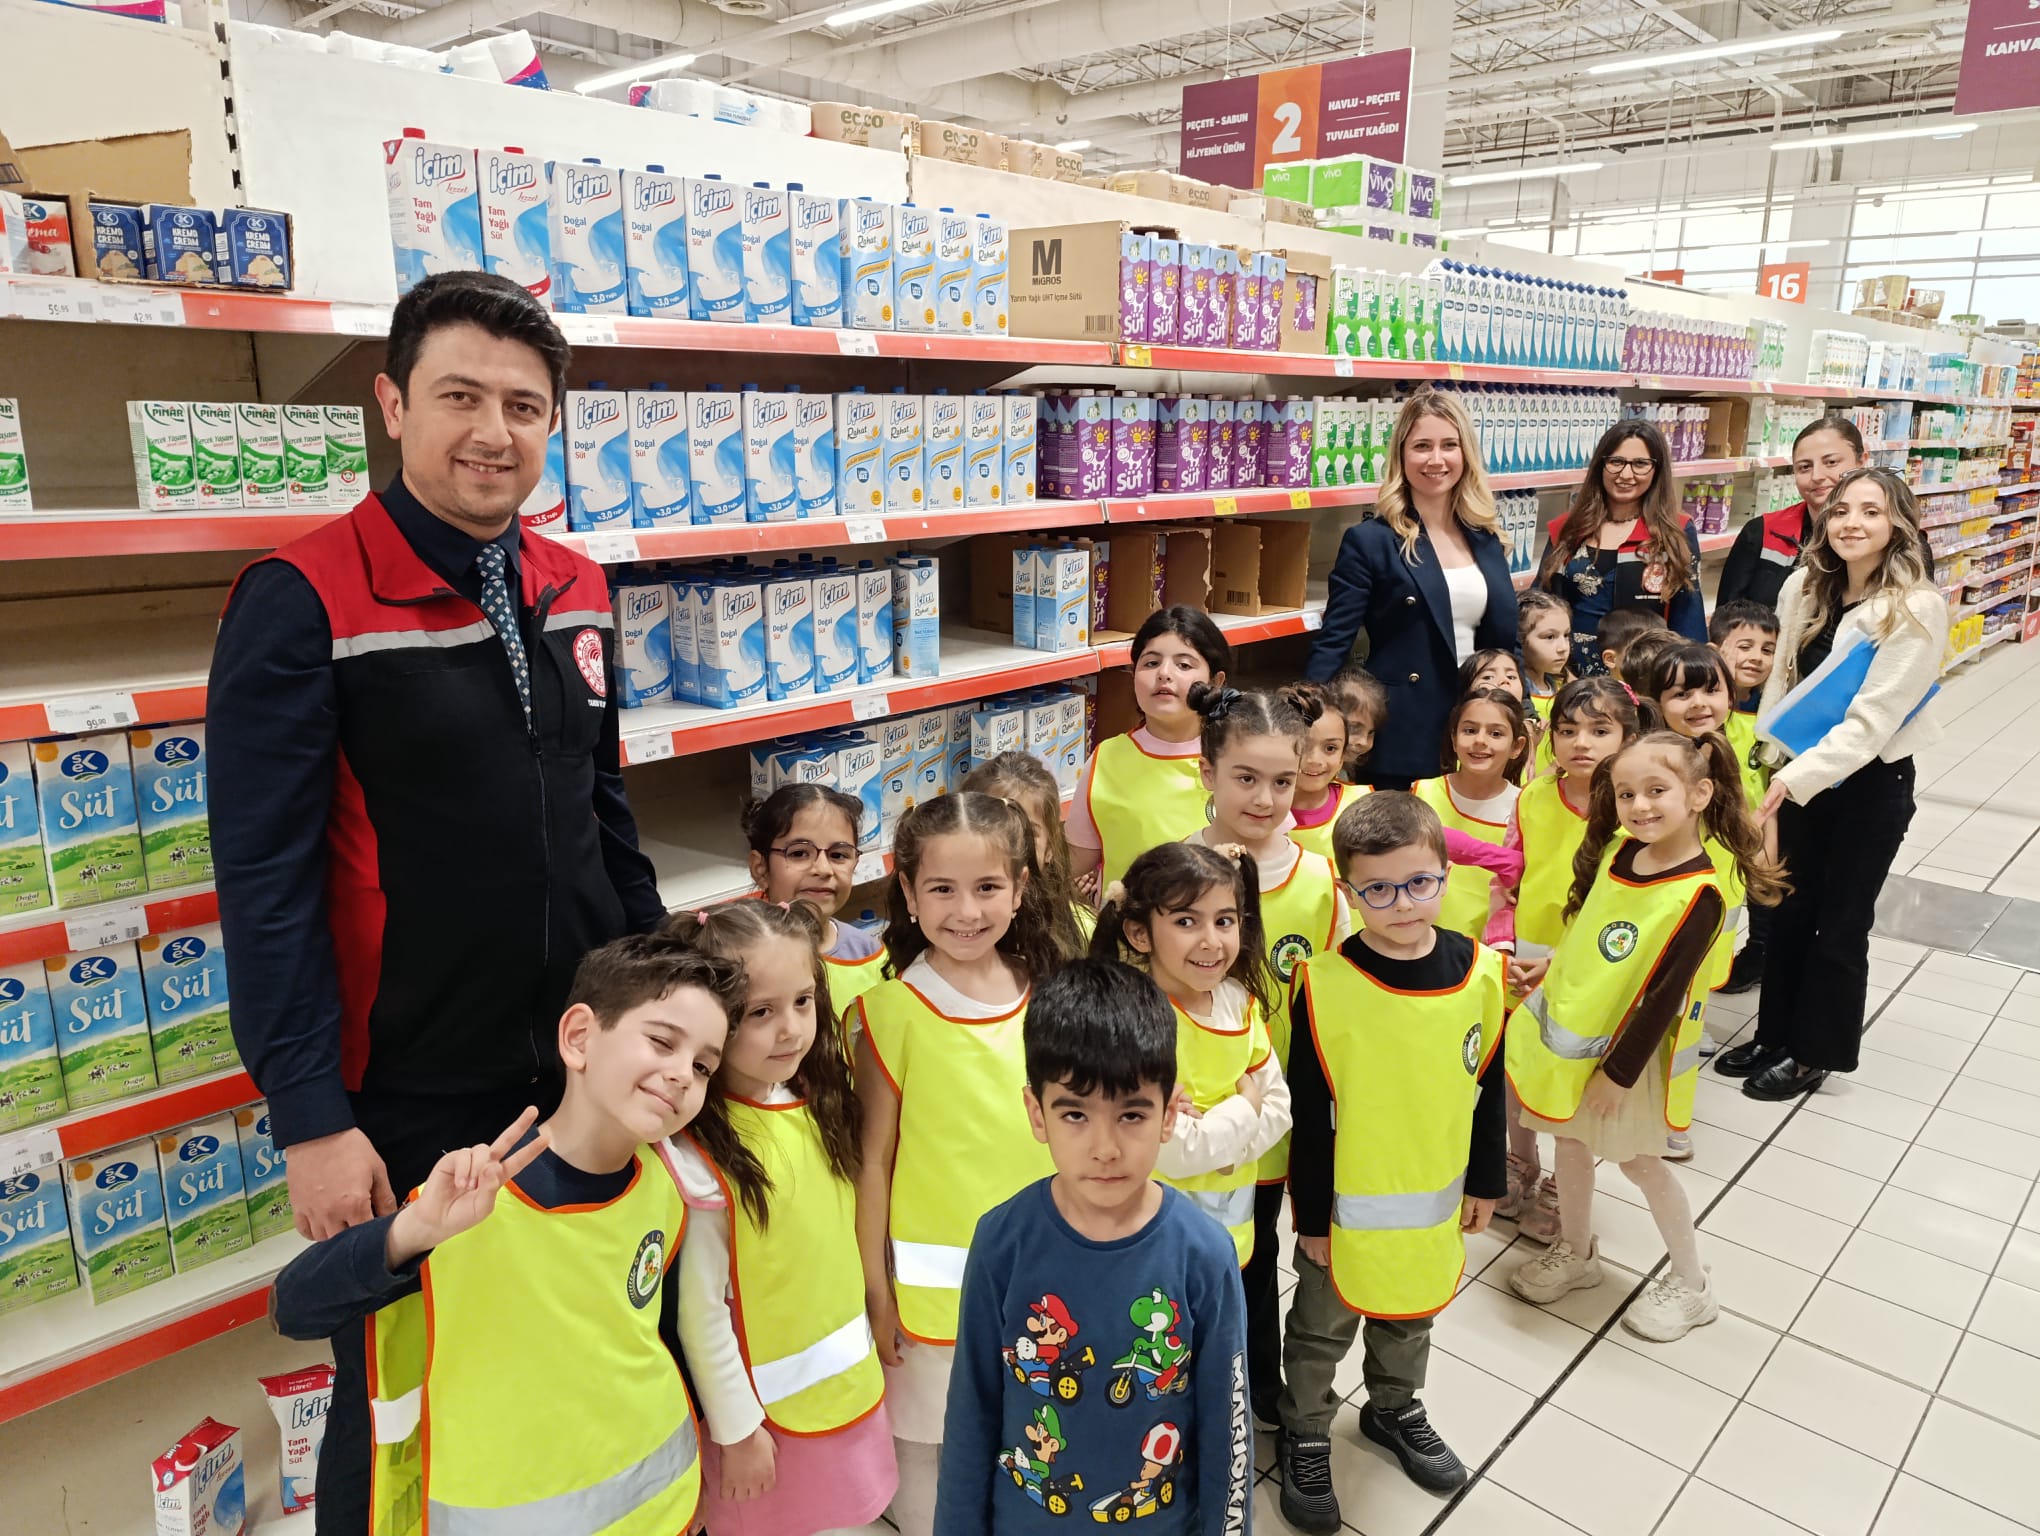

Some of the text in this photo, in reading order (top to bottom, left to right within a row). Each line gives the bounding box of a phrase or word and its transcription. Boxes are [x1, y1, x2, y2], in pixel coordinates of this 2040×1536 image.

[1328, 91, 1401, 110] HAVLU PEÇETE
[1186, 112, 1248, 131] PEÇETE SABUN
[1272, 102, 1302, 154] 2
[1326, 123, 1399, 142] TUVALET KAĞIDI
[415, 147, 463, 186] İçim
[1056, 154, 1082, 172] ecco
[490, 157, 533, 196] İçim
[567, 168, 608, 205] İçim
[414, 198, 432, 209] Tam
[634, 176, 673, 212] İçim
[694, 183, 731, 218] İçim
[1188, 187, 1210, 201] ecco
[414, 210, 436, 223] Yağlı
[488, 206, 506, 216] Tam
[745, 191, 779, 225] İçim
[798, 198, 831, 229] İçim
[417, 223, 430, 234] Süt
[489, 217, 509, 230] Yağlı
[564, 216, 586, 228] Doğal
[564, 226, 576, 236] Süt
[632, 222, 652, 232] Doğal
[691, 227, 712, 239] Doğal
[490, 230, 503, 240] Süt
[632, 232, 643, 241] Süt
[742, 234, 760, 245] Doğal
[795, 239, 813, 249] Doğal
[1033, 239, 1062, 275] M
[1767, 274, 1800, 299] 16
[1124, 312, 1145, 335] Süt
[1153, 314, 1173, 337] Süt
[1183, 317, 1204, 342] Süt
[1207, 320, 1226, 342] Süt
[1238, 322, 1256, 343] Süt
[1260, 324, 1278, 345] Süt
[577, 397, 617, 430] İçim
[637, 397, 675, 429] İçim
[696, 398, 732, 429] İçim
[753, 399, 785, 428] İçim
[574, 440, 595, 451] Doğal
[634, 439, 655, 450] Doğal
[693, 438, 713, 449] Doğal
[695, 448, 705, 457] Süt
[750, 438, 768, 448] Doğal
[1083, 470, 1106, 494] Süt
[1117, 470, 1143, 492] Süt
[1181, 466, 1200, 488] Süt
[1211, 464, 1228, 484] Süt
[1238, 463, 1257, 483] Süt
[1289, 463, 1308, 483] Süt
[775, 587, 804, 615] İçim
[820, 582, 849, 609] İçim
[864, 577, 886, 603] İçim
[627, 591, 661, 620] İçim
[723, 591, 754, 621] İçim
[625, 628, 642, 638] Doğal
[721, 630, 737, 638] Doğal
[845, 750, 873, 778] İçim
[152, 771, 207, 813] Süt
[60, 785, 119, 829] Süt
[161, 967, 215, 1012] Süt
[68, 988, 127, 1034] Süt
[178, 1162, 228, 1206] Süt
[0, 1201, 50, 1246] Süt
[94, 1190, 148, 1235] Süt
[288, 1437, 308, 1447] Tam
[288, 1446, 311, 1456] Yağlı
